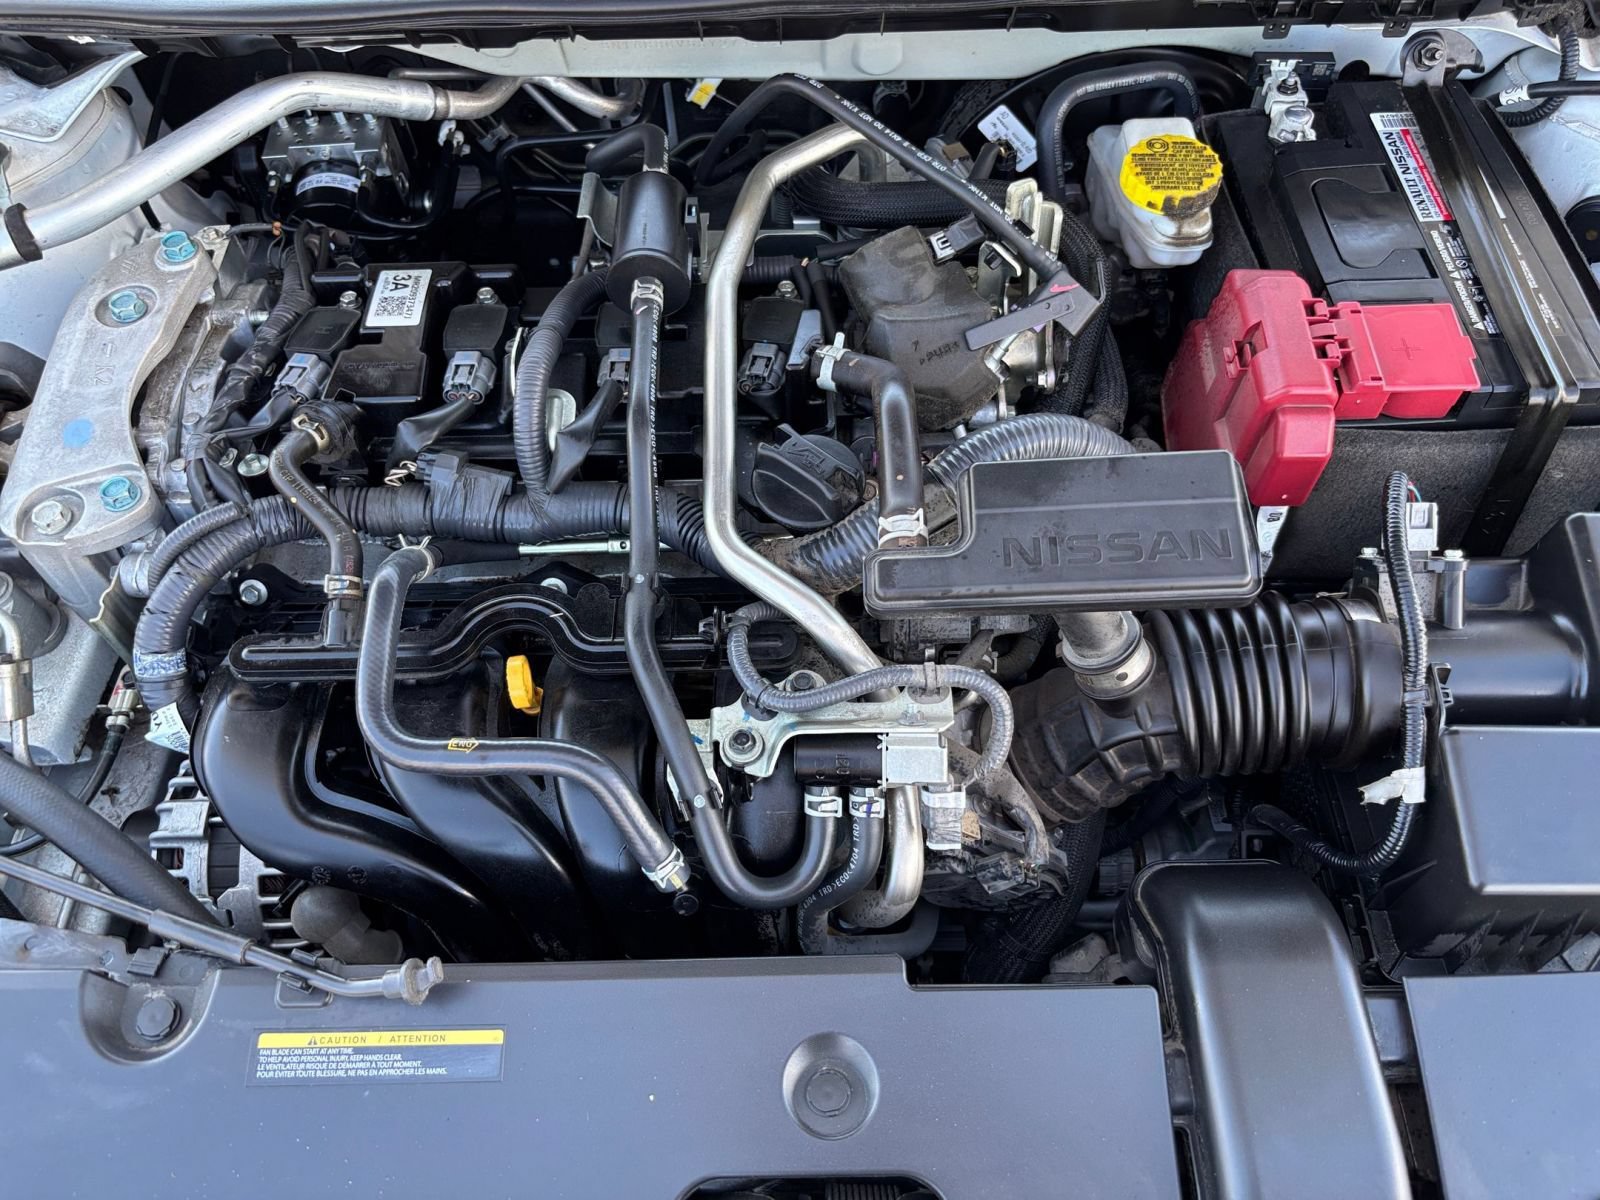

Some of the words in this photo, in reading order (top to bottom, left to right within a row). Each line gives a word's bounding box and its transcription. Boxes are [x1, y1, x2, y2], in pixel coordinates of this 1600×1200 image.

[858, 112, 874, 123] NOT
[1382, 132, 1412, 175] NISSAN
[1404, 177, 1434, 219] RENAULT
[389, 274, 412, 292] 3A
[1002, 528, 1235, 568] NISSAN
[320, 1036, 366, 1044] CAUTION
[389, 1034, 446, 1043] ATTENTION
[350, 1054, 364, 1062] KEEP
[306, 1062, 328, 1070] RISQUE
[378, 1068, 414, 1076] APPROCHER
[426, 1067, 448, 1075] MAINS.
